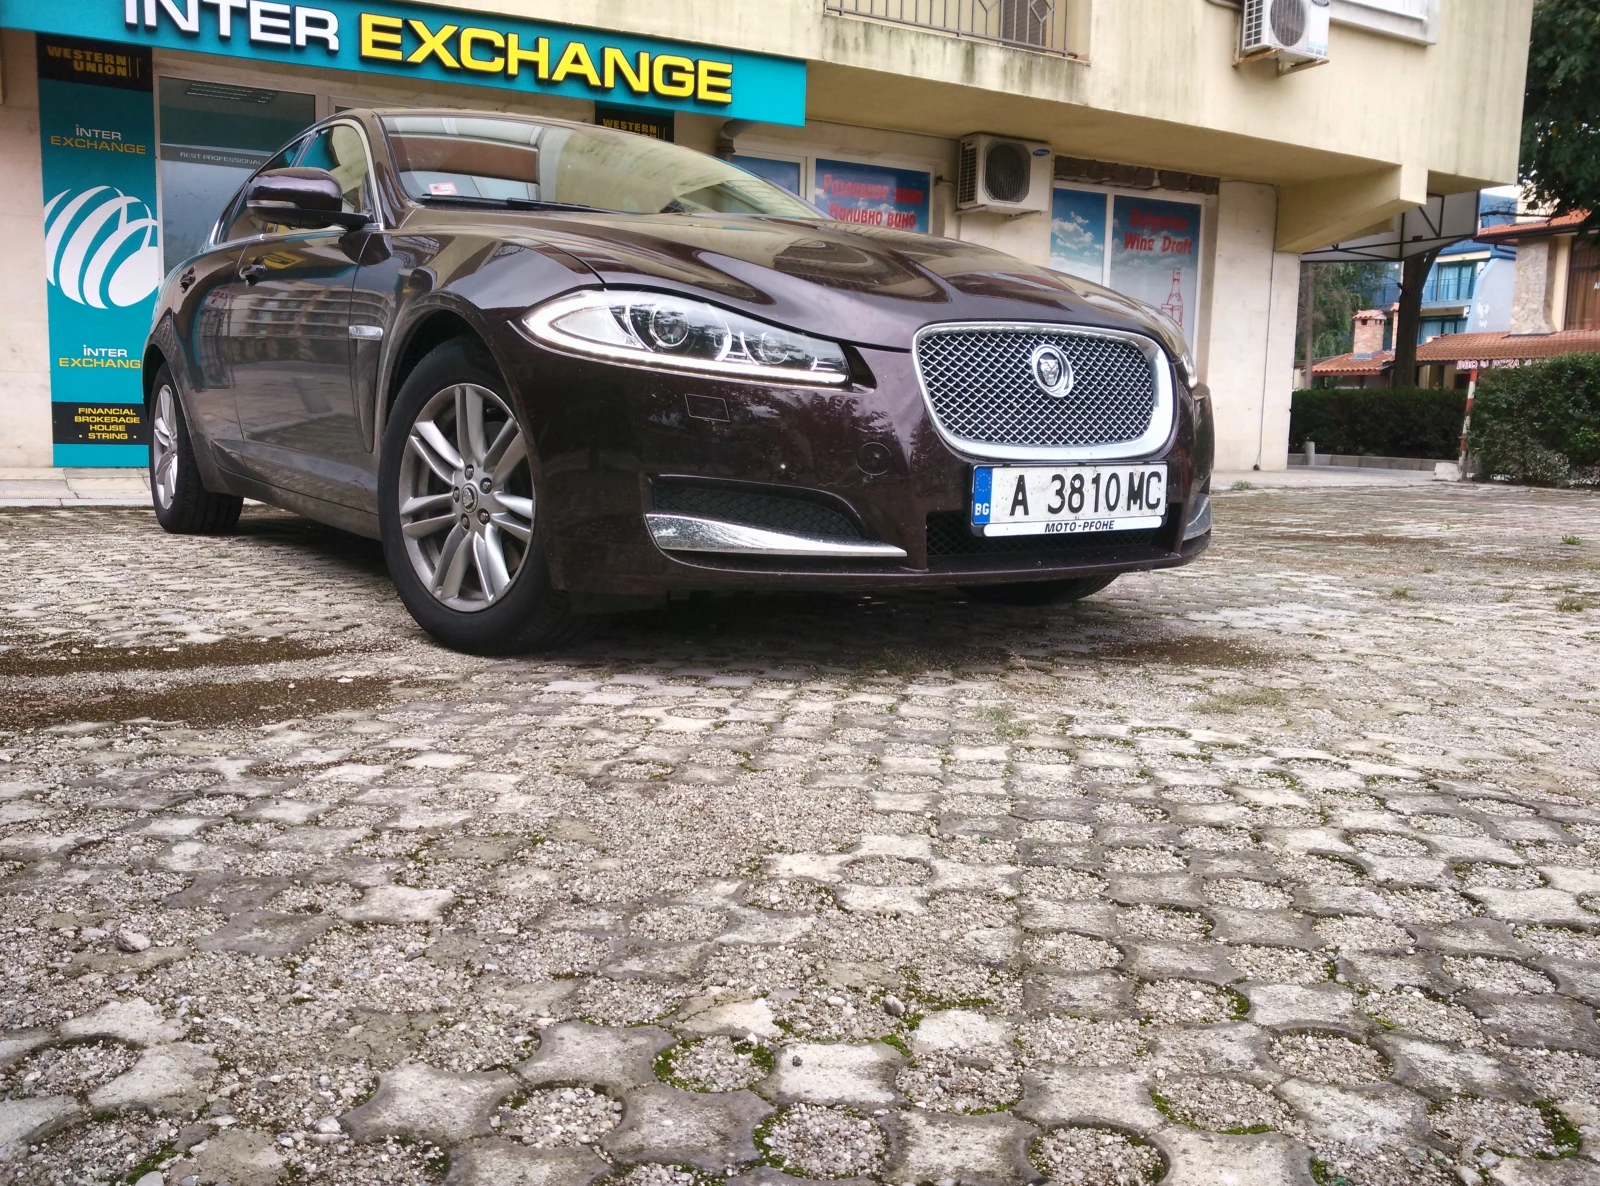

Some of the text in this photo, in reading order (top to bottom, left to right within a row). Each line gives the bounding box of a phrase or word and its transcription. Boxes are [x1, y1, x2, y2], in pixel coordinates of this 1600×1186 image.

[46, 45, 127, 66] WESTERN
[358, 12, 733, 104] EXCHANGE
[73, 60, 128, 77] UNION
[602, 118, 658, 134] WESTERN
[50, 135, 146, 155] EXCHANGE
[1124, 232, 1193, 255] Wine Draft
[59, 357, 141, 369] EXCHANG
[78, 407, 136, 415] FINANCIAL
[74, 415, 141, 424] BROKERAGE
[89, 424, 126, 432] HOUSE
[88, 432, 128, 440] STRING
[1009, 471, 1162, 517] A 3810 MC
[974, 502, 990, 516] BG
[1044, 520, 1115, 533] MOTO-PFOHE
